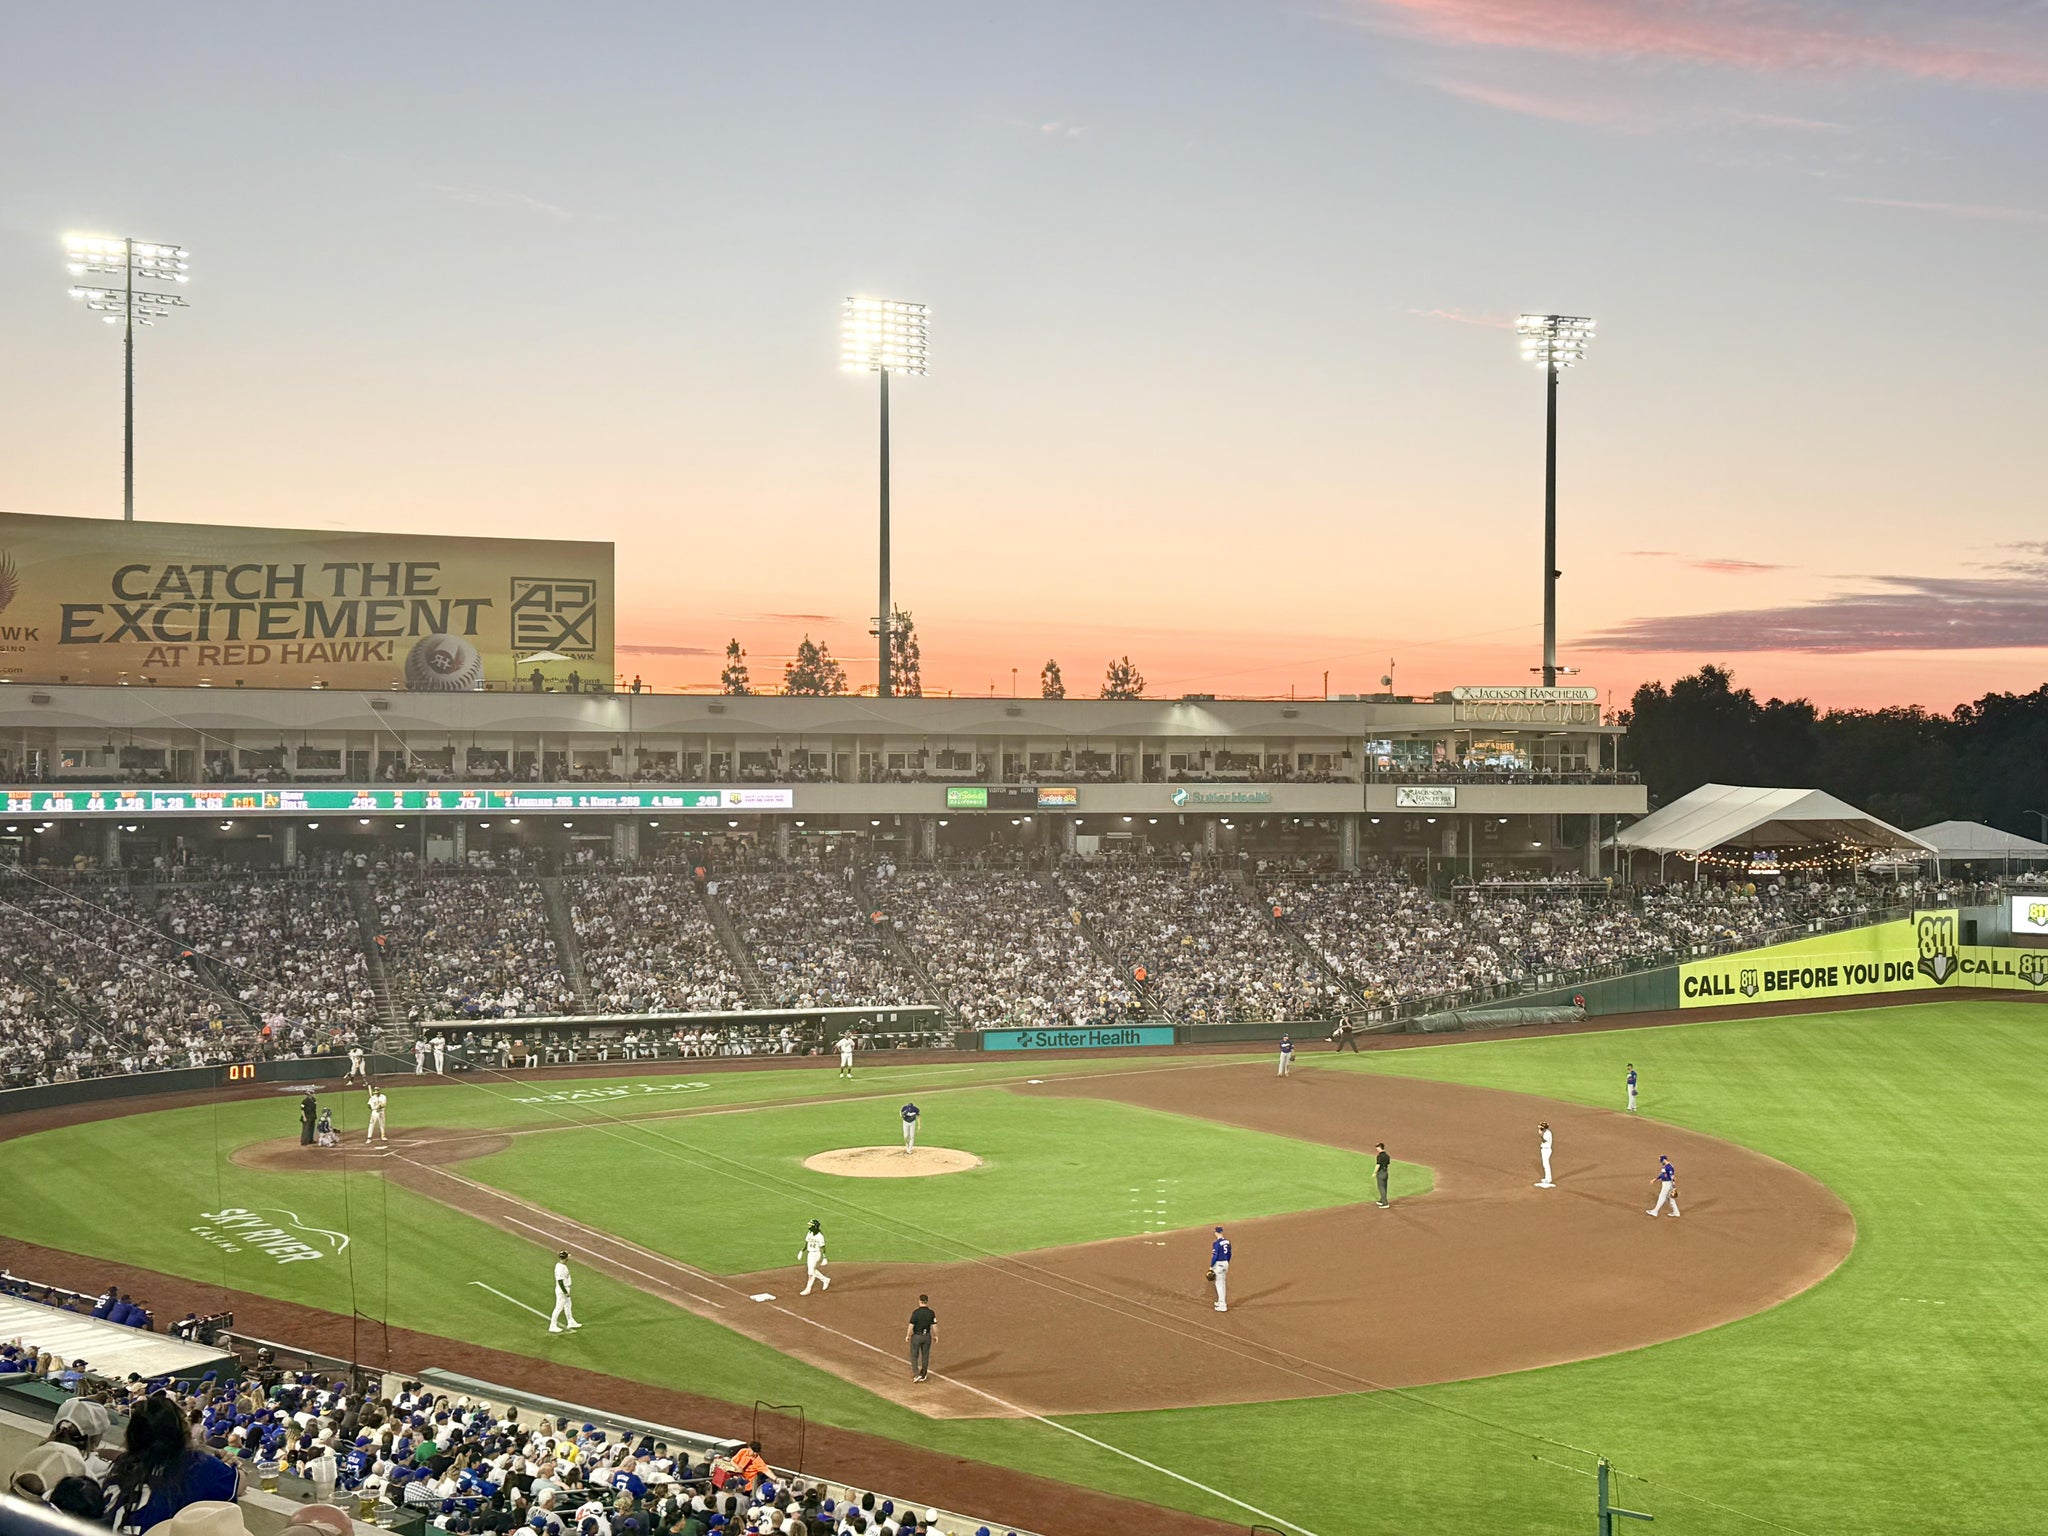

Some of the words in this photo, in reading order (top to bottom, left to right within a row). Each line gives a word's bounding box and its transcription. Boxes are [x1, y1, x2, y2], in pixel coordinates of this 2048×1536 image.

[112, 563, 306, 602] CATCH
[321, 562, 441, 597] THE
[57, 598, 493, 645] EXCITEMENT
[142, 645, 189, 667] AT
[197, 644, 271, 666] RED
[280, 640, 394, 664] HAWK!
[1475, 688, 1526, 699] JACKSON
[1530, 688, 1588, 699] RANCHERIA
[1919, 916, 1954, 960] 811
[1684, 974, 1735, 998] CALL
[1741, 969, 1758, 987] 811
[1764, 966, 1838, 991] BEFORE
[1843, 963, 1880, 985] YOU
[1884, 961, 1914, 982] DIG
[1960, 959, 2016, 975] CALL
[1035, 1032, 1087, 1047] Sutter
[1089, 1030, 1141, 1045] Health
[200, 1208, 273, 1229] SKY
[189, 1226, 243, 1253] CASINO
[236, 1228, 324, 1264] RIVER
[1223, 1244, 1229, 1254] 5
